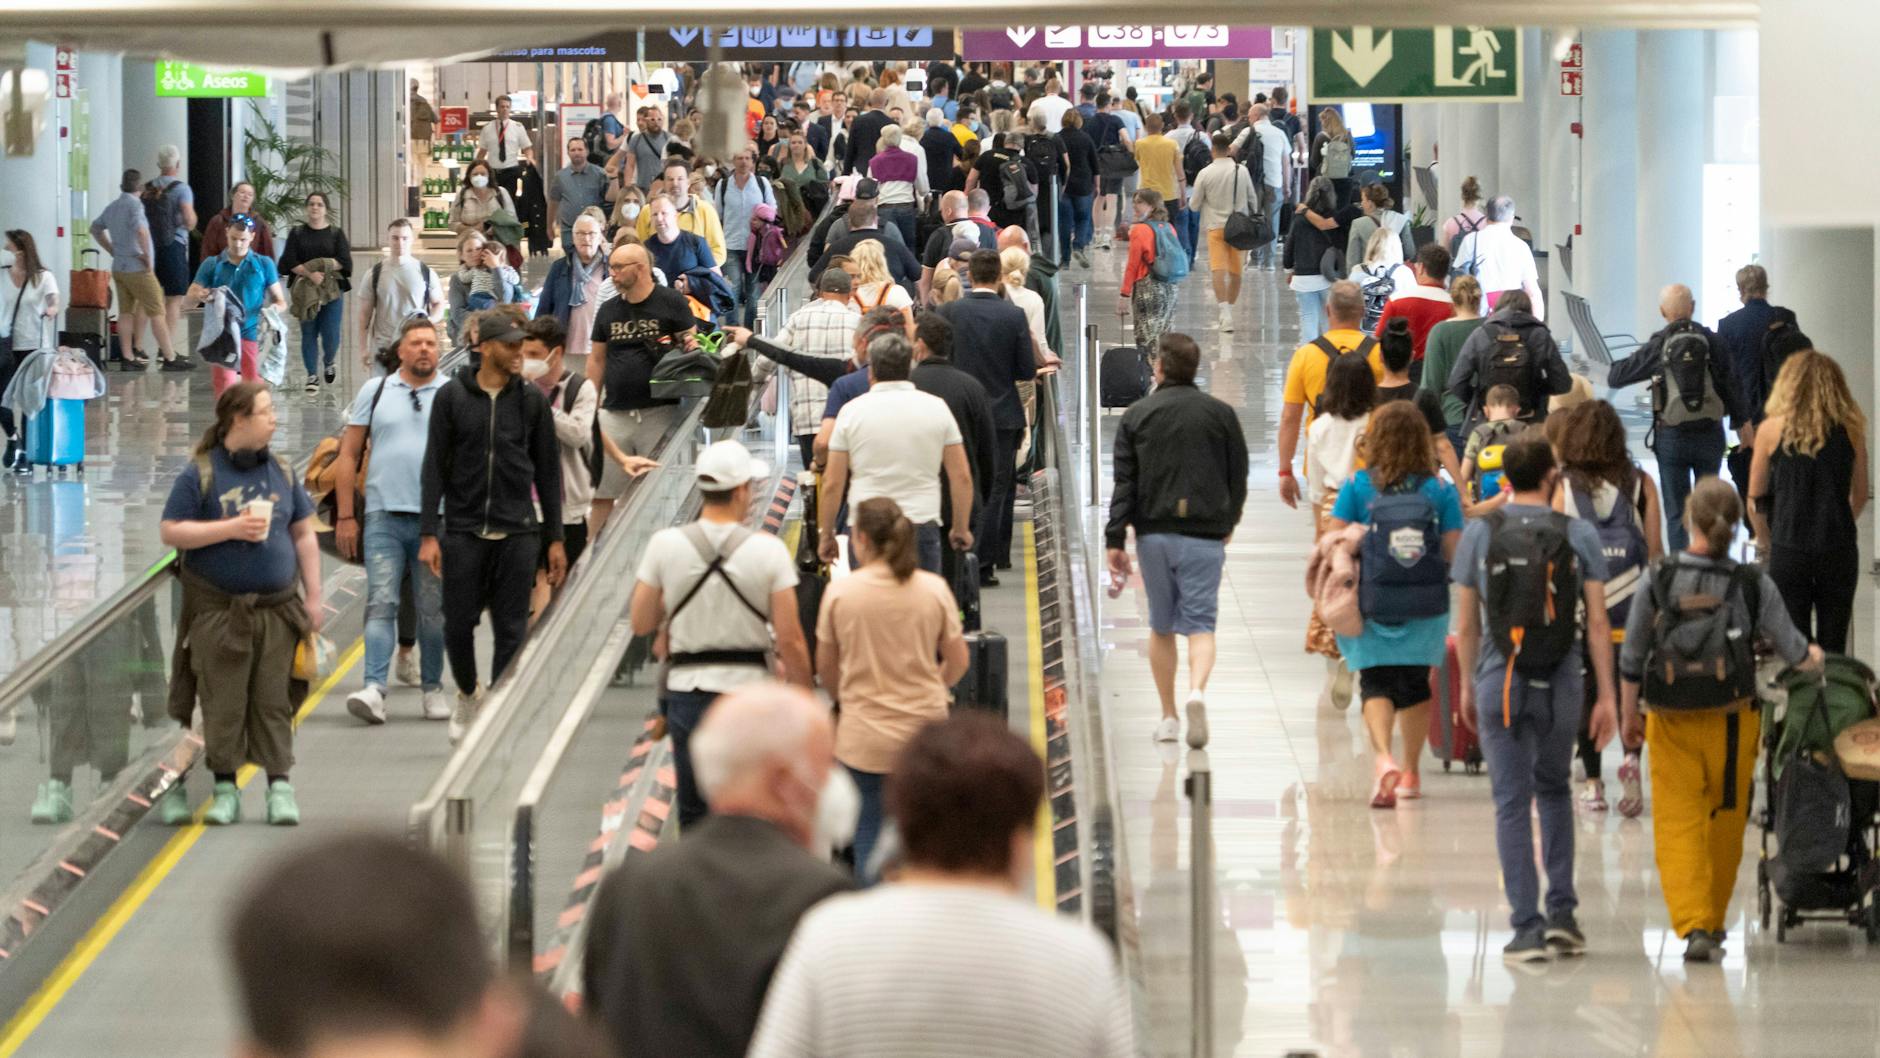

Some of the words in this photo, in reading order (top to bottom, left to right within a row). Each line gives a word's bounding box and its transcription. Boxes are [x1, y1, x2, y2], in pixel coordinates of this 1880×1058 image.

[1096, 25, 1143, 39] C38
[530, 48, 554, 57] para
[556, 47, 607, 56] mascotas
[202, 73, 249, 89] Aseos
[610, 319, 660, 335] BOSS
